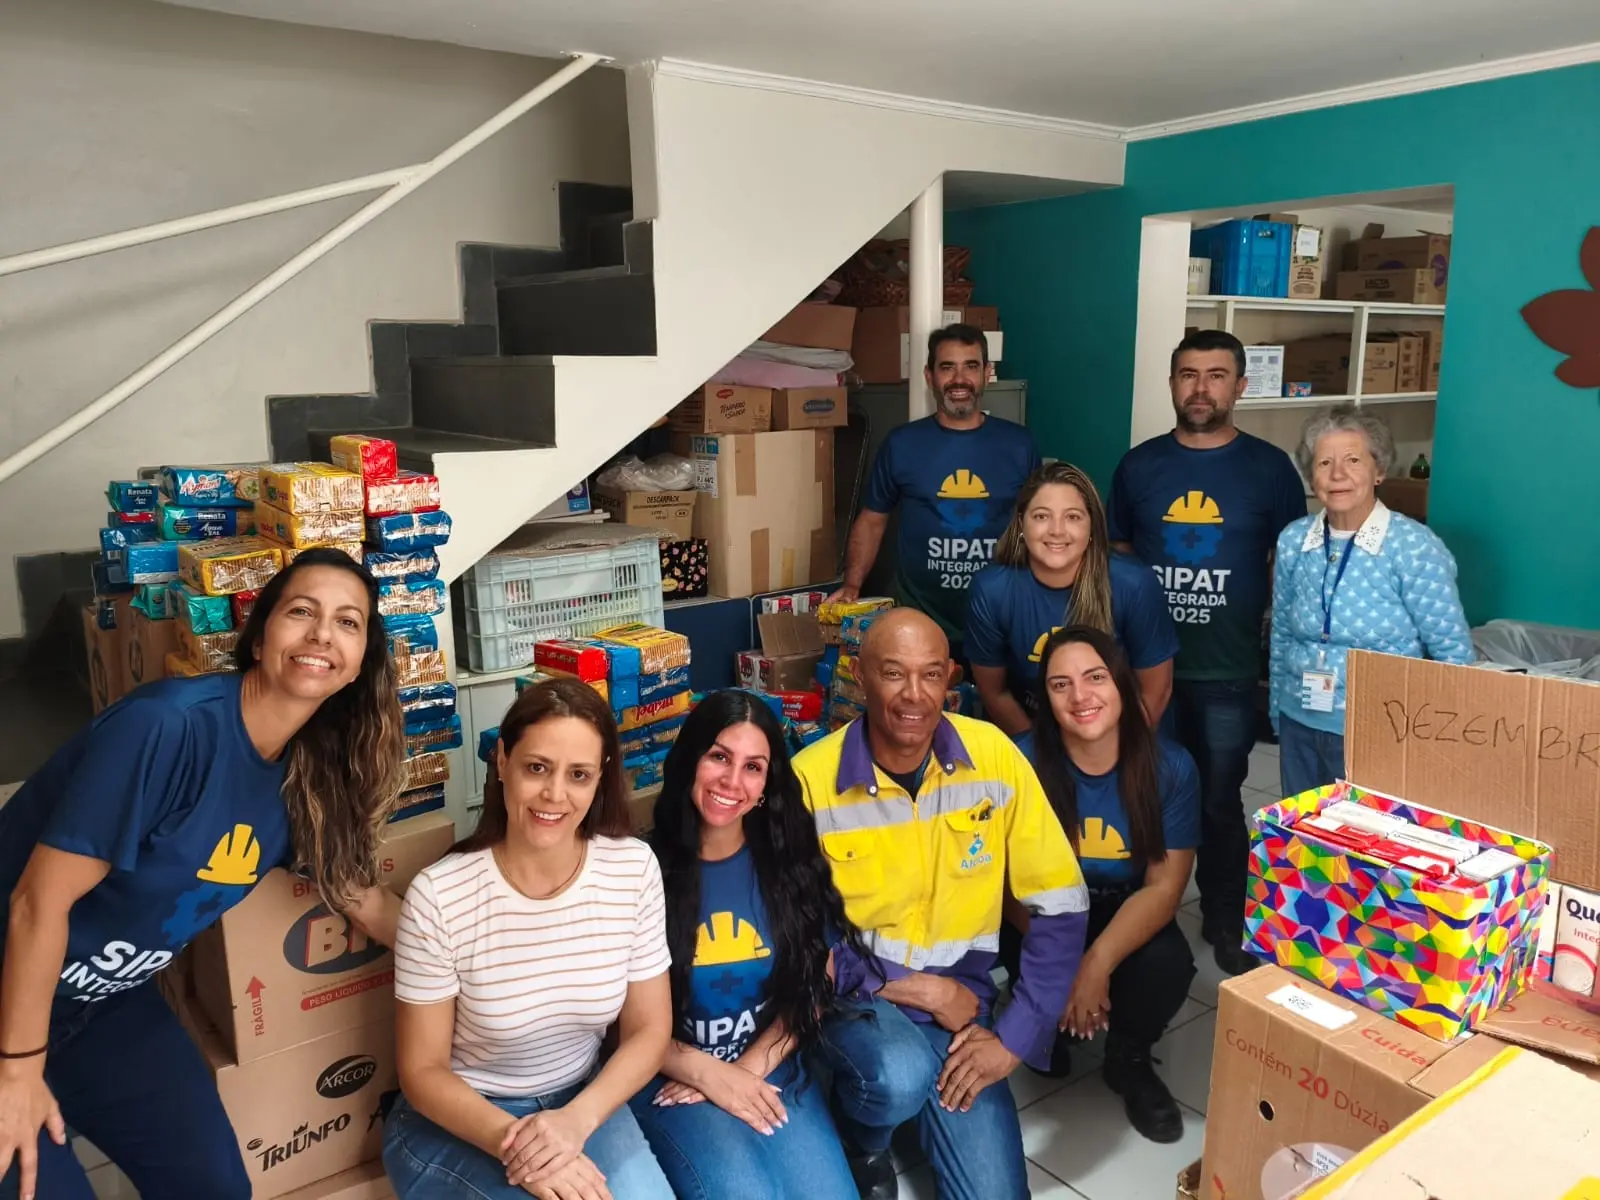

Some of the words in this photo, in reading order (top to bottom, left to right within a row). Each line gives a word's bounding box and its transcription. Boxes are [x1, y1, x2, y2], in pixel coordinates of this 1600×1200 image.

[198, 512, 226, 520] Renata
[928, 537, 998, 560] SIPAT
[941, 573, 972, 589] 202
[1164, 592, 1227, 606] EGRADA
[1168, 606, 1210, 624] 025
[90, 940, 173, 979] SIP
[309, 992, 333, 1007] PESO
[1361, 1028, 1428, 1066] Cuida
[318, 1064, 375, 1093] ARCOR
[1225, 1028, 1293, 1080] Contém
[1297, 1066, 1329, 1100] 20
[1334, 1089, 1390, 1134] Dúzia
[256, 1112, 352, 1172] TRIUNFO
